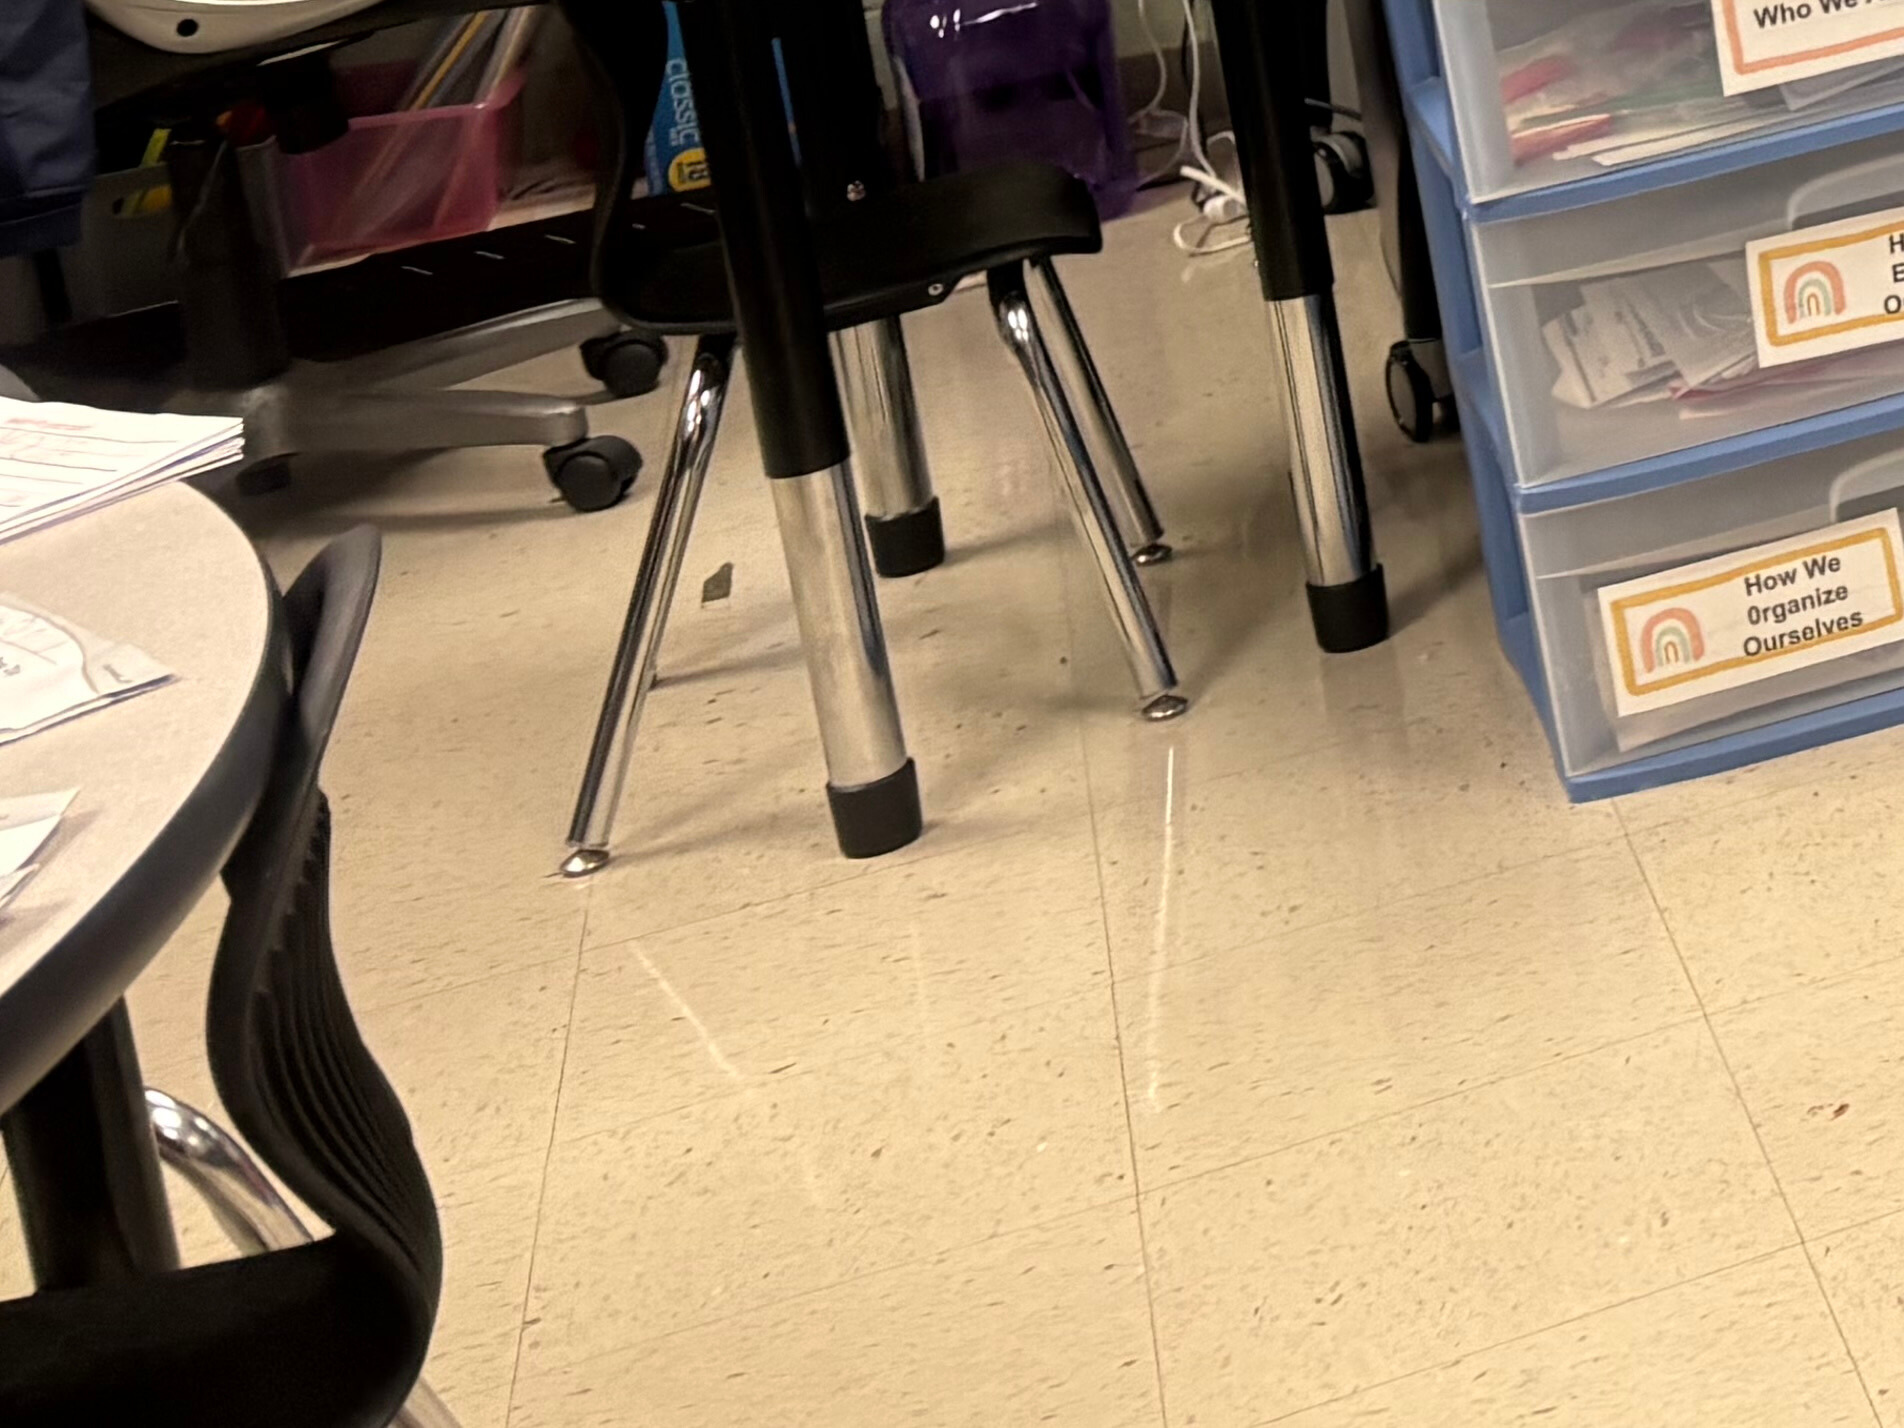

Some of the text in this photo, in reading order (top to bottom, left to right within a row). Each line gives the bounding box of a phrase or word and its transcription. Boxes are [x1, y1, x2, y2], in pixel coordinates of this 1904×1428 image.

[1743, 555, 1842, 598] How We
[1742, 612, 1864, 657] Ourselves
